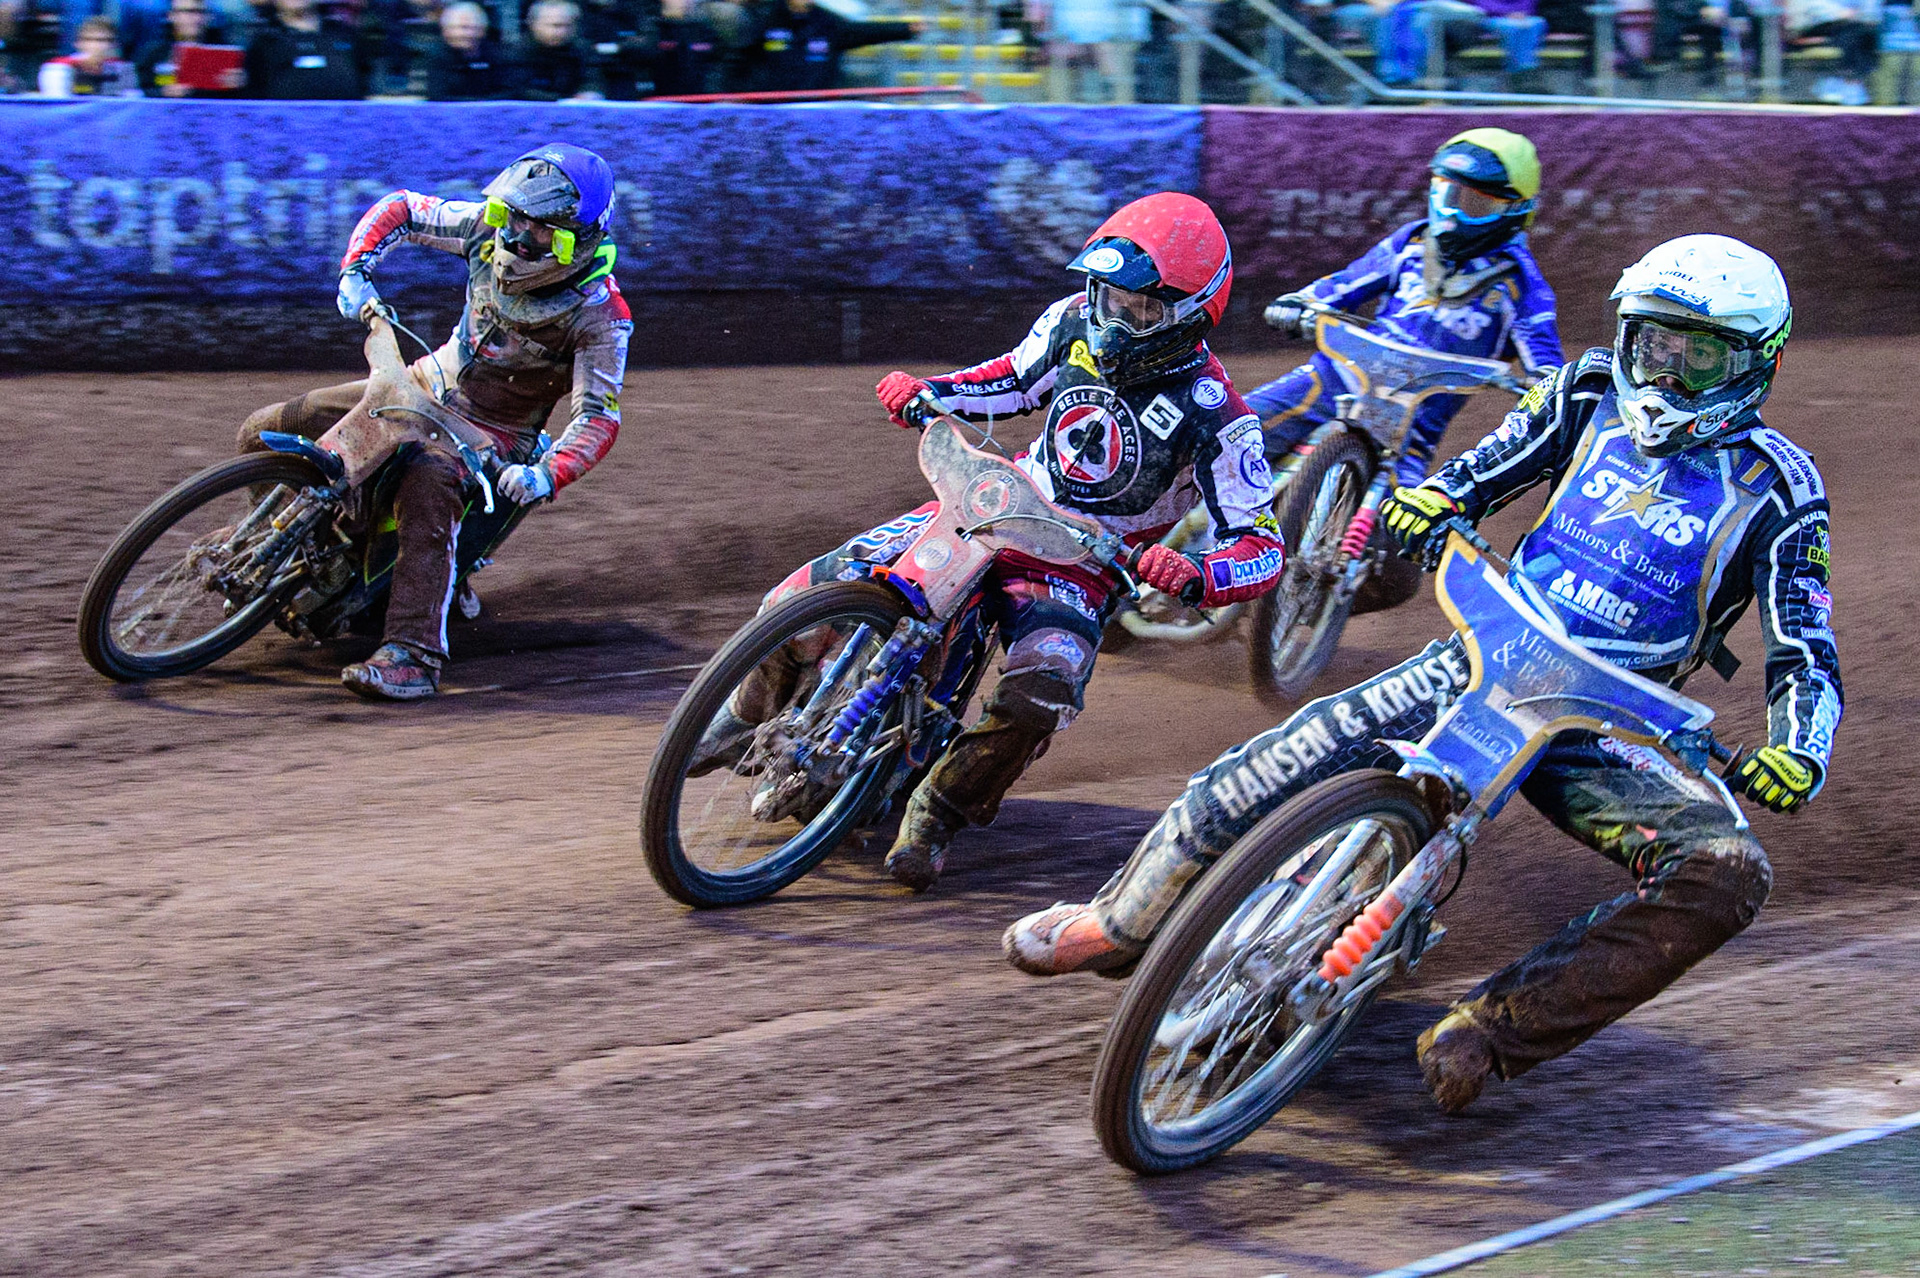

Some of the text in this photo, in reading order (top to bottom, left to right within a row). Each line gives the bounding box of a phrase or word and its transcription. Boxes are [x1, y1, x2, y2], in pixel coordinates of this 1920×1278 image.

[1057, 392, 1136, 463] BELLE VUE ACES
[1739, 459, 1770, 486] 1
[1553, 513, 1686, 595] Minors & Brady
[1572, 578, 1640, 628] MRC
[1491, 639, 1518, 669] &
[1512, 628, 1581, 684] Minors
[1211, 650, 1470, 820] HANSEN & KRUSE
